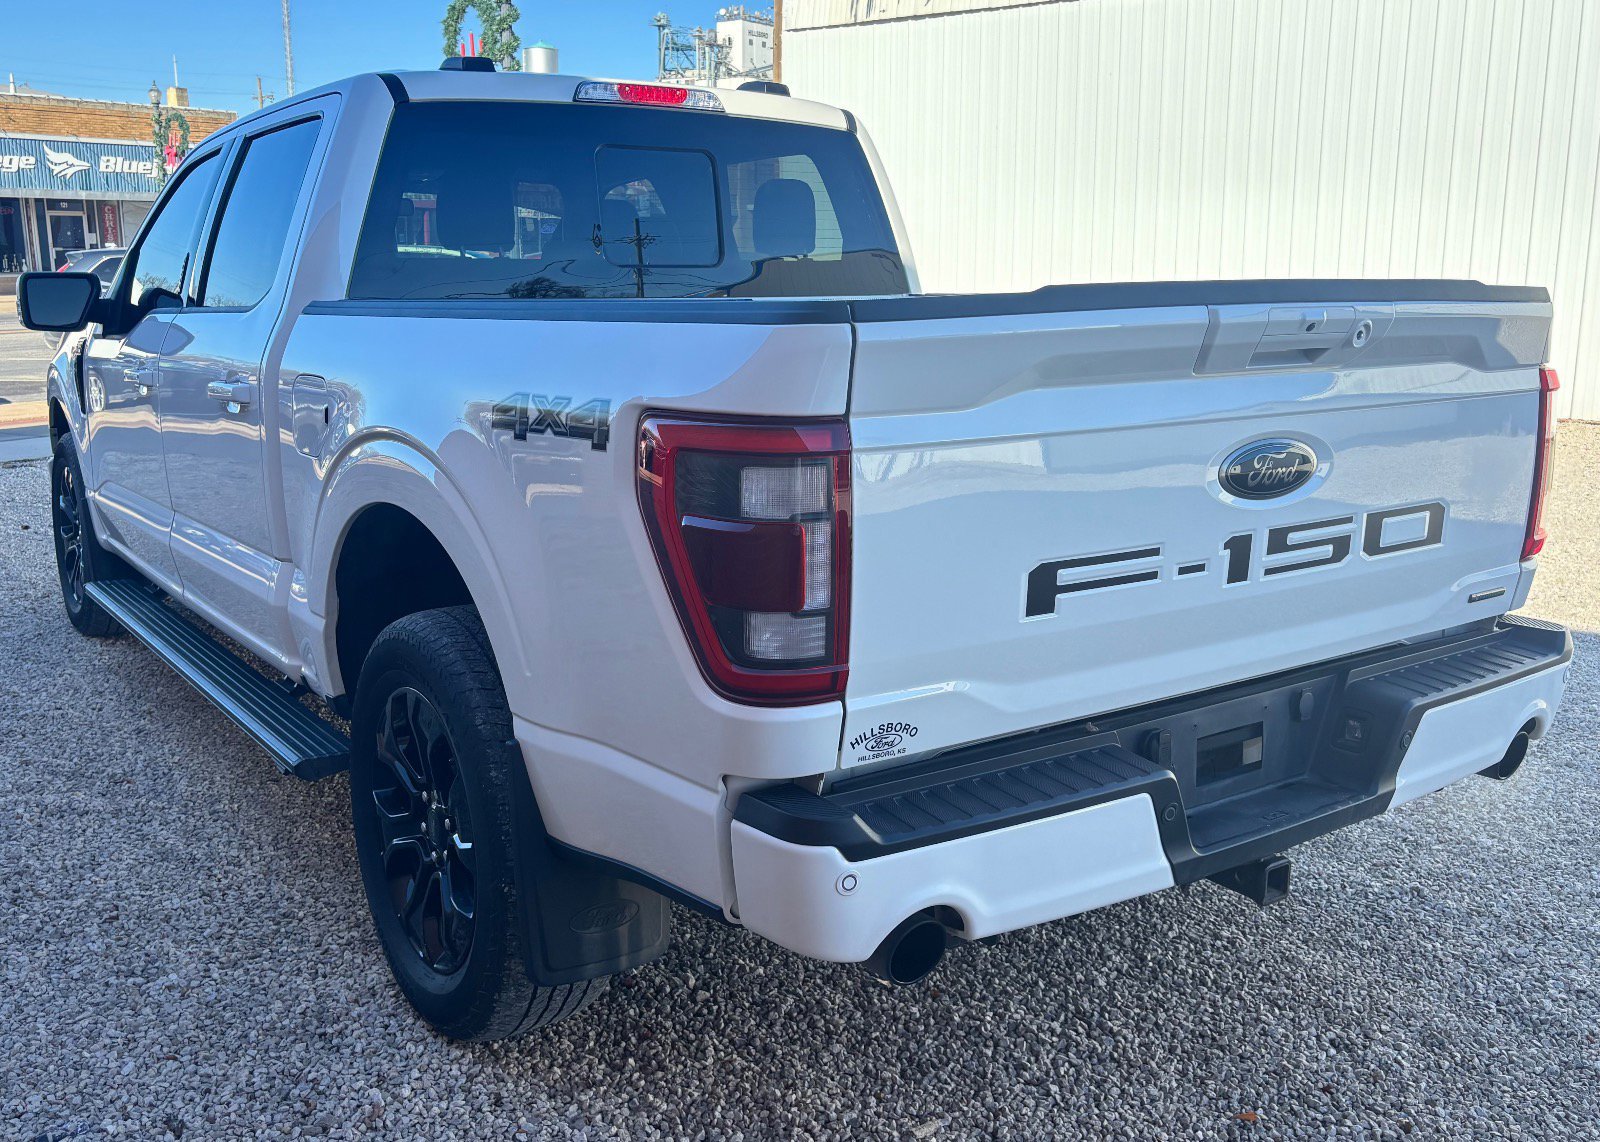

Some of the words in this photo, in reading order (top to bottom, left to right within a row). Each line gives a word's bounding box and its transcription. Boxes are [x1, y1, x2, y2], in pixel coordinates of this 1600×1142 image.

[748, 30, 768, 39] HILLSBORO
[0, 155, 36, 173] ge
[1248, 452, 1300, 487] Ford
[1022, 501, 1448, 620] F-150
[849, 722, 918, 750] HILLSBORO
[870, 735, 897, 750] Ford
[857, 750, 896, 763] HILLSBORO,
[897, 747, 907, 757] KS
